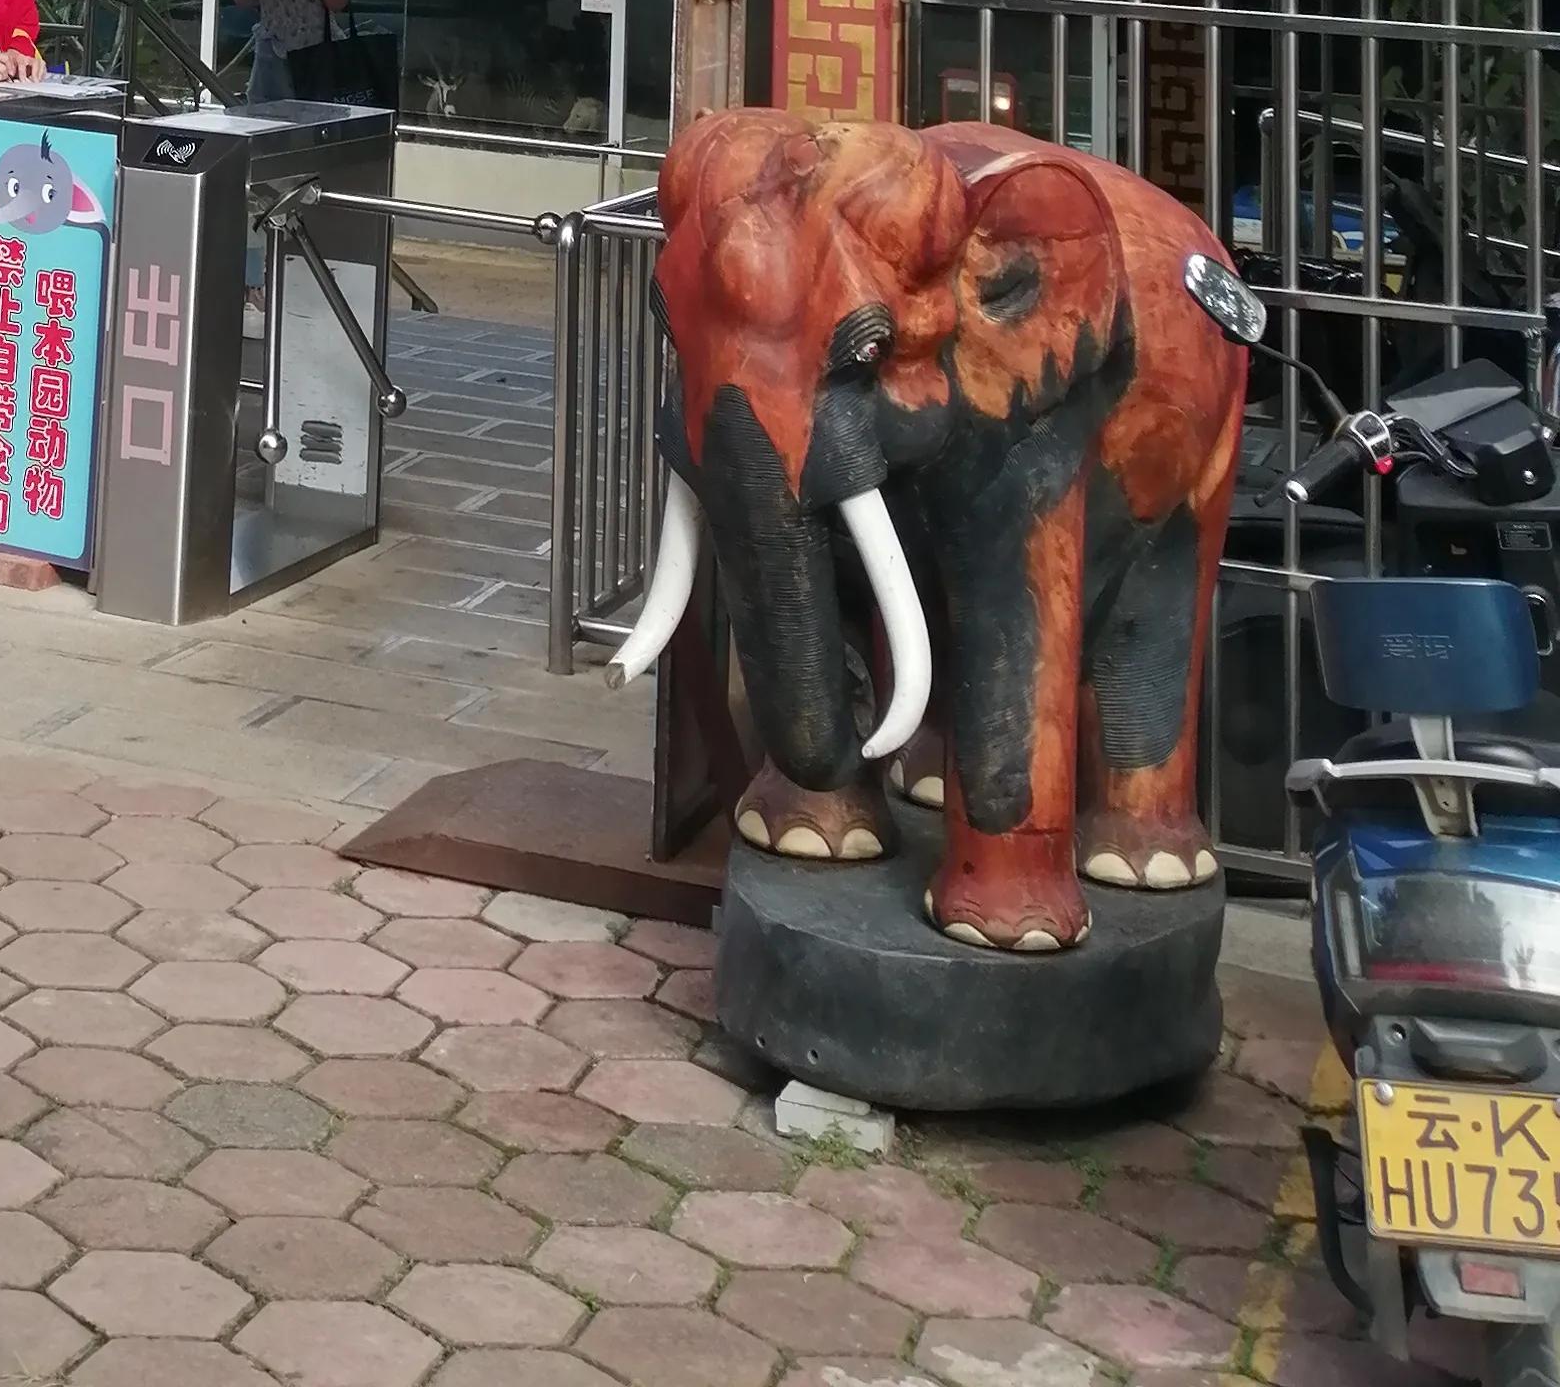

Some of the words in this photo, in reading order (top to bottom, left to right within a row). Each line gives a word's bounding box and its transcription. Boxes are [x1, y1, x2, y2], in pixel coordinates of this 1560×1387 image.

[22, 268, 79, 520] 喂本园动物
[119, 263, 181, 466] 出口
[1379, 1156, 1560, 1238] HU73
